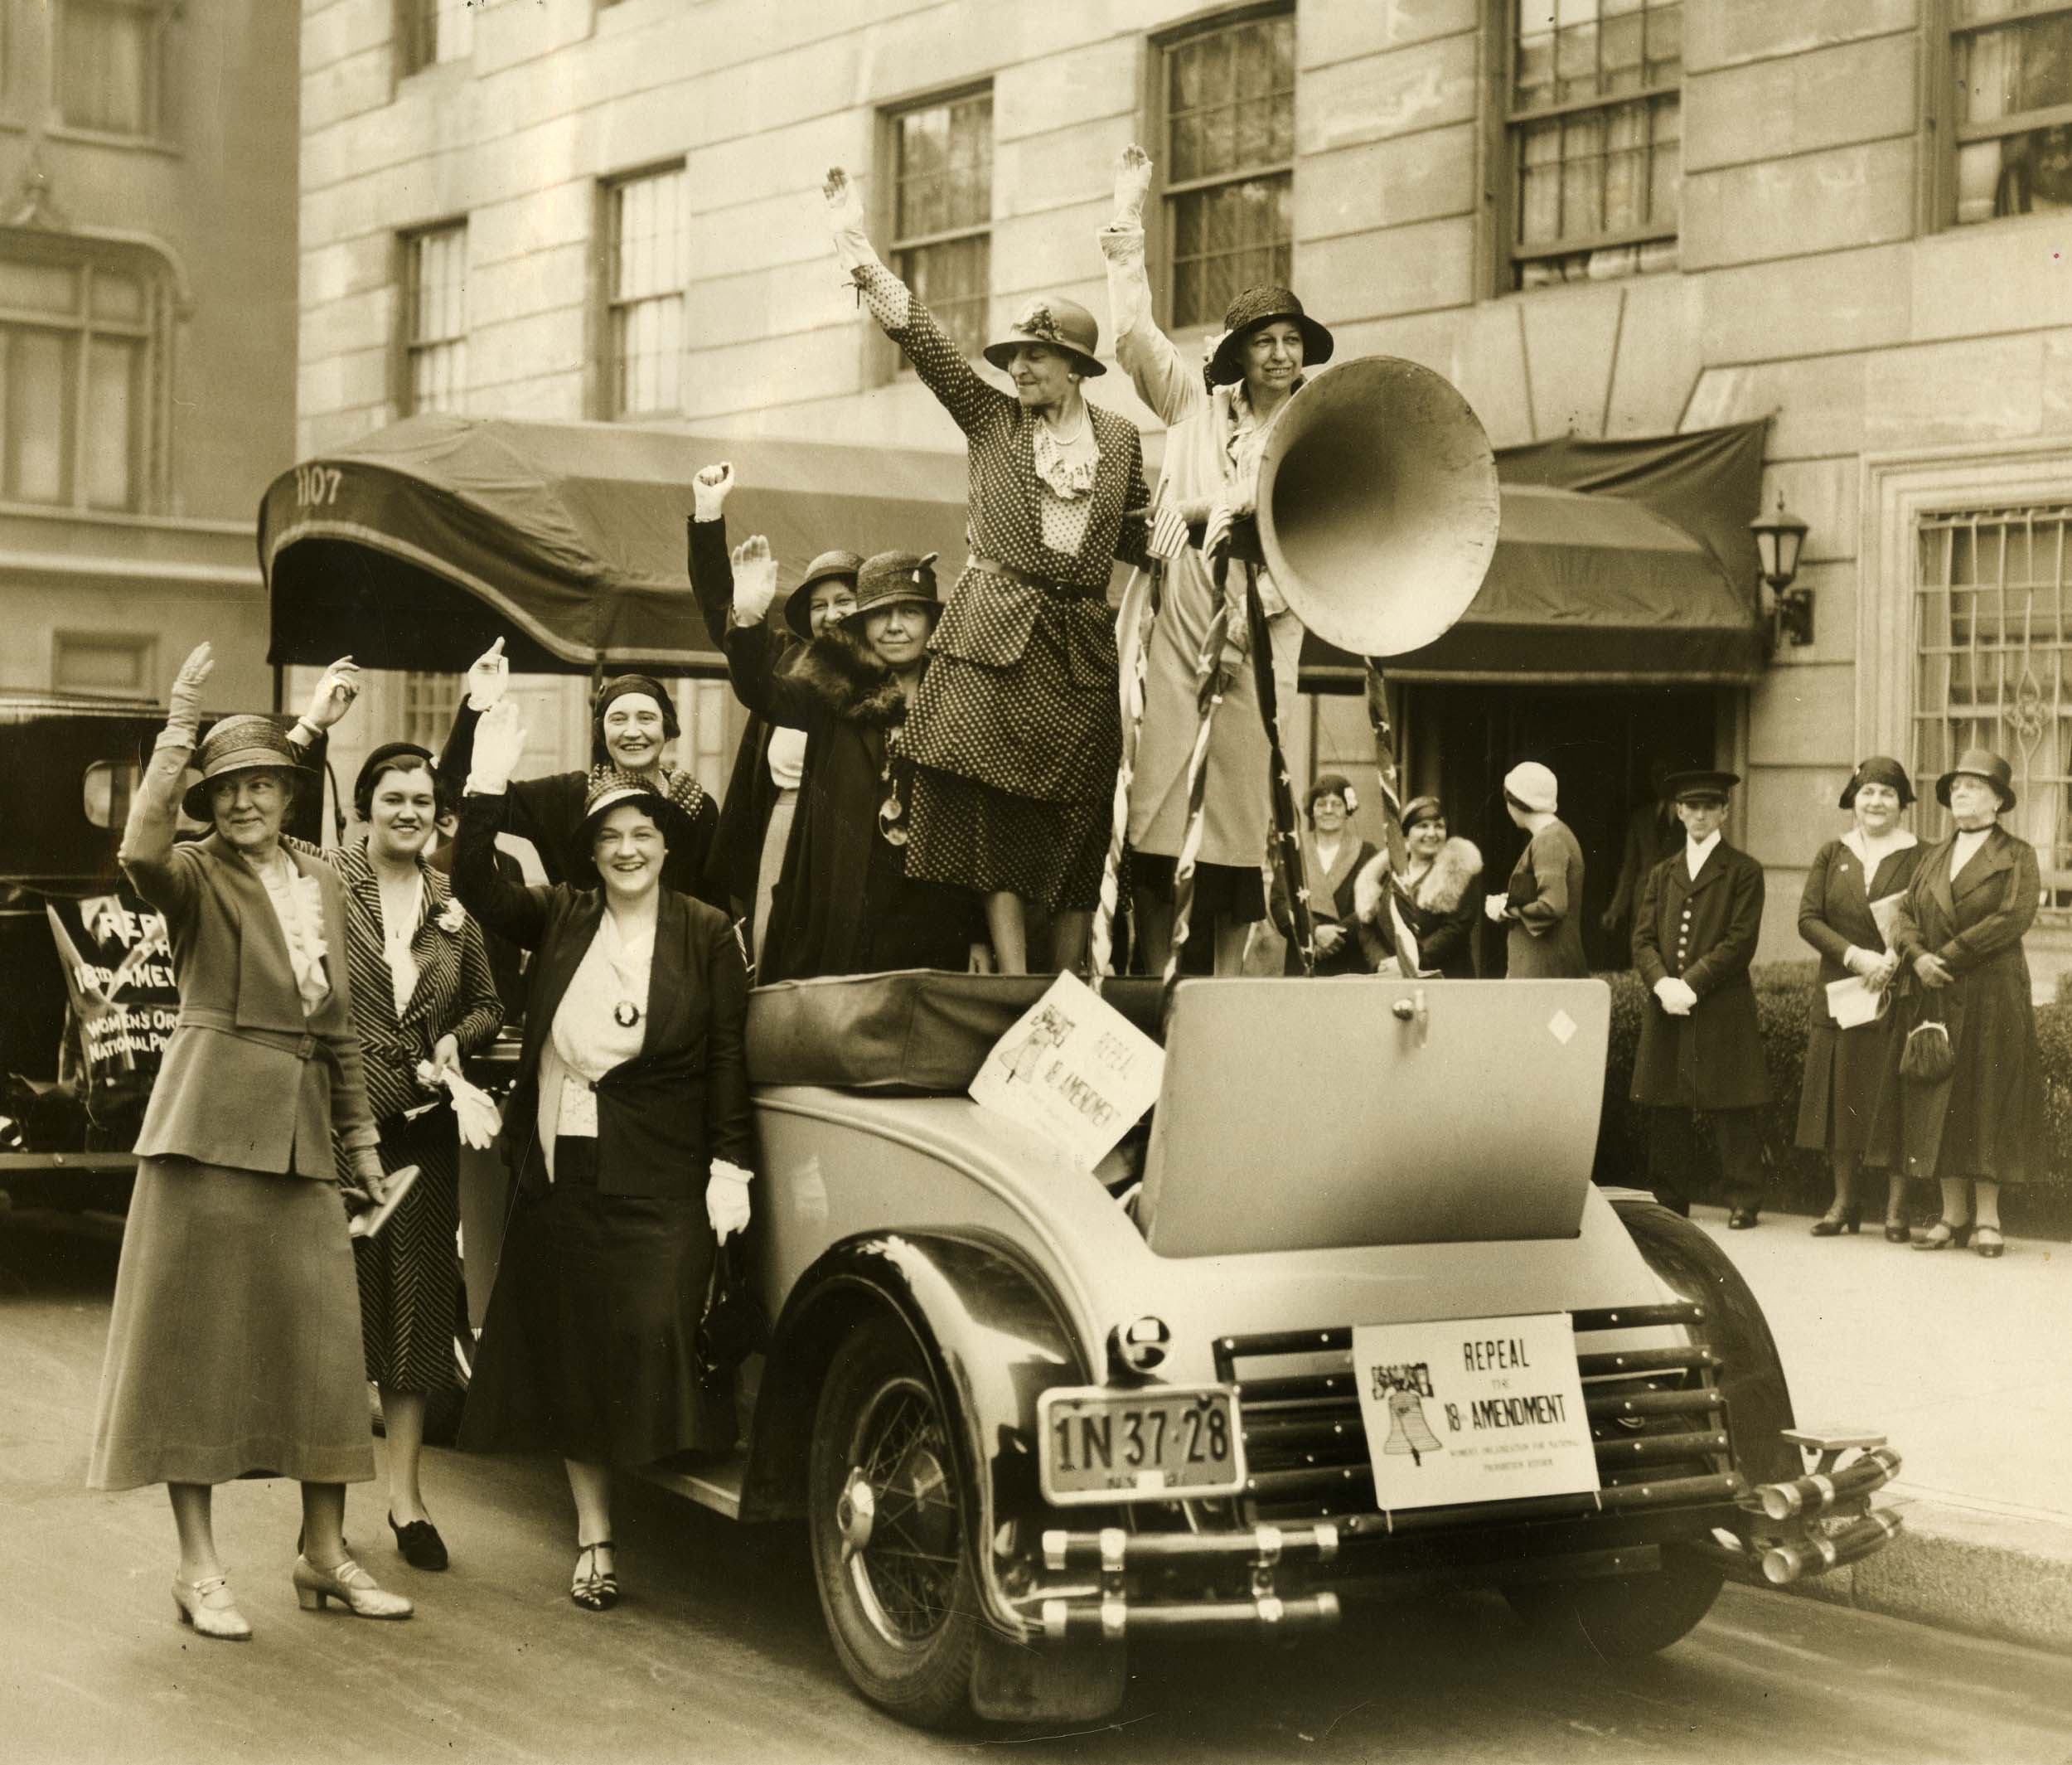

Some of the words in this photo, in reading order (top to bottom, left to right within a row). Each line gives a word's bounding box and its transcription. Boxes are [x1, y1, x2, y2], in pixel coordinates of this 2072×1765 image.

[296, 464, 342, 506] 1107
[88, 1035, 150, 1063] NATIONAL
[1464, 1339, 1530, 1371] REPEAL
[1471, 1394, 1566, 1430] AMENDMENT
